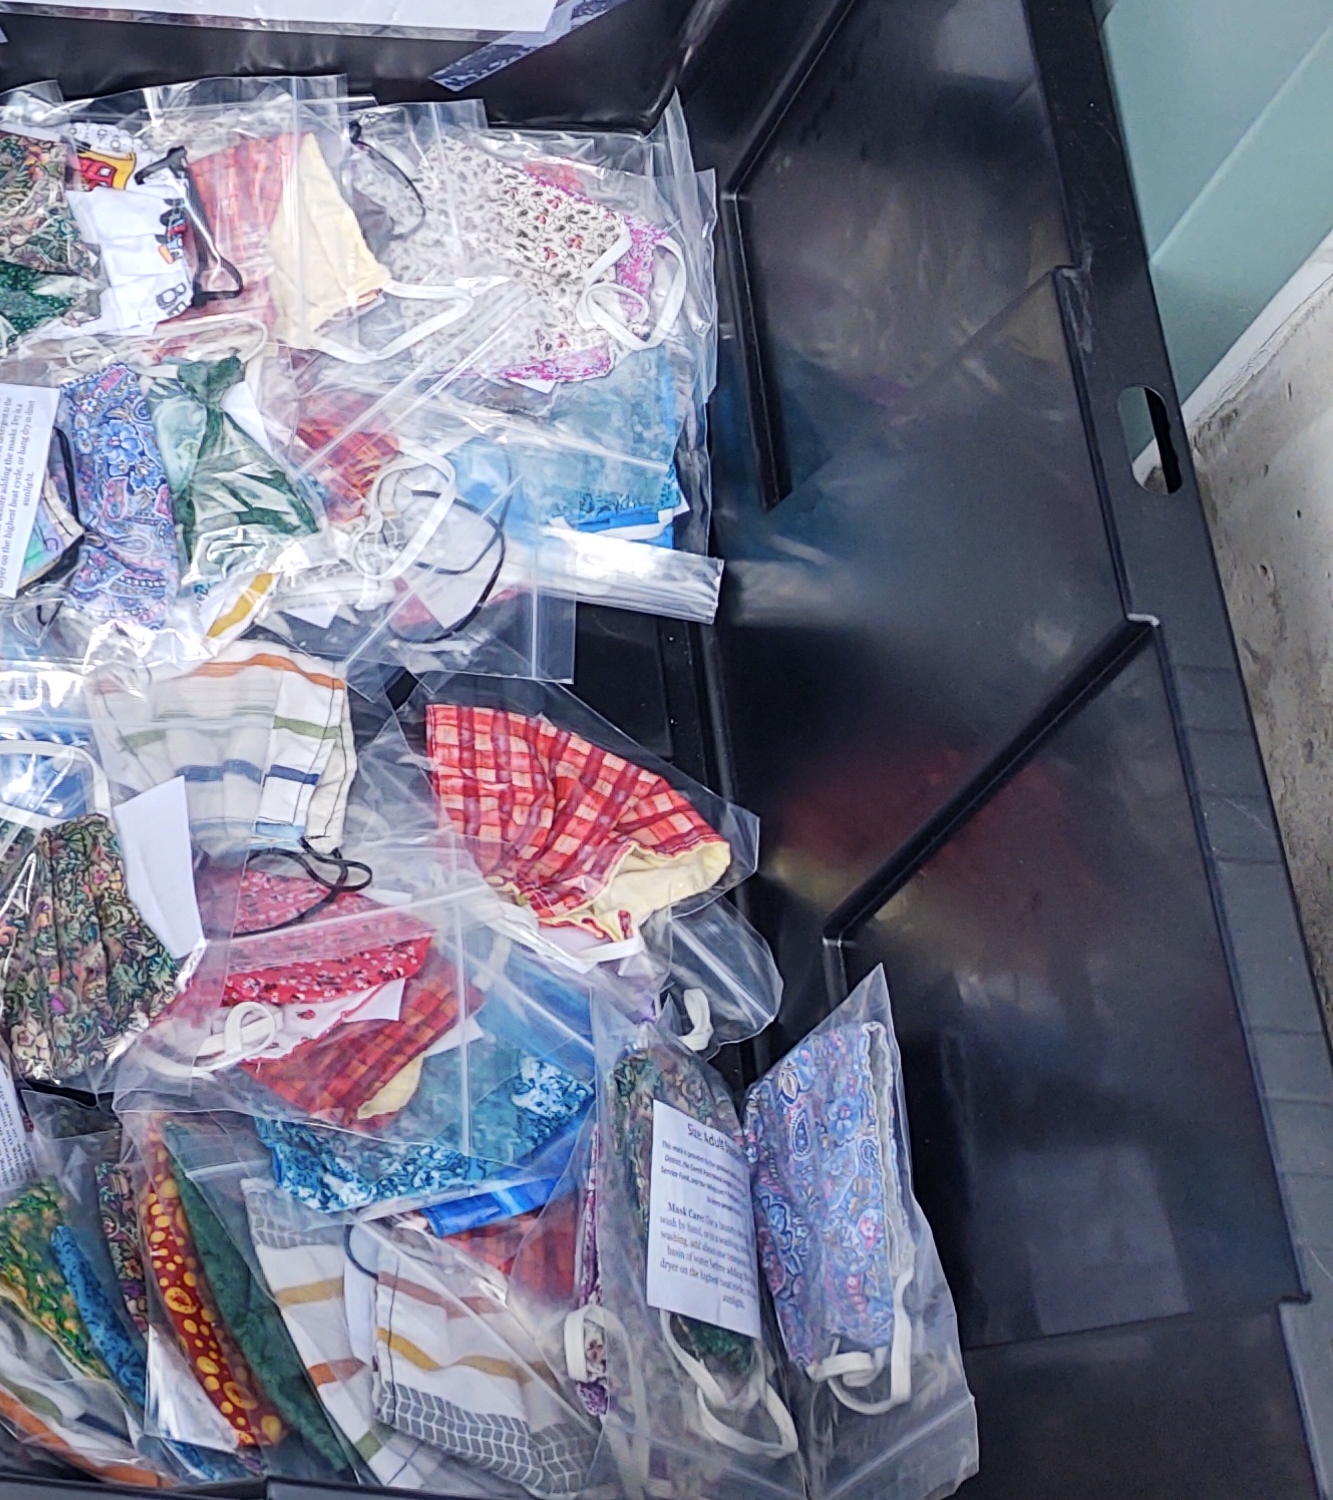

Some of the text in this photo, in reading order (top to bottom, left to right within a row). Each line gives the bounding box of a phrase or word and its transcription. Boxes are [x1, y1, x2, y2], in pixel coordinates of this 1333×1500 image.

[19, 423, 32, 435] dry
[15, 435, 29, 455] hang
[2, 452, 14, 465] the
[16, 455, 25, 465] or
[10, 465, 25, 489] cycle,
[7, 489, 19, 507] heat
[3, 508, 19, 538] highest
[0, 538, 12, 553] the
[0, 554, 9, 565] on
